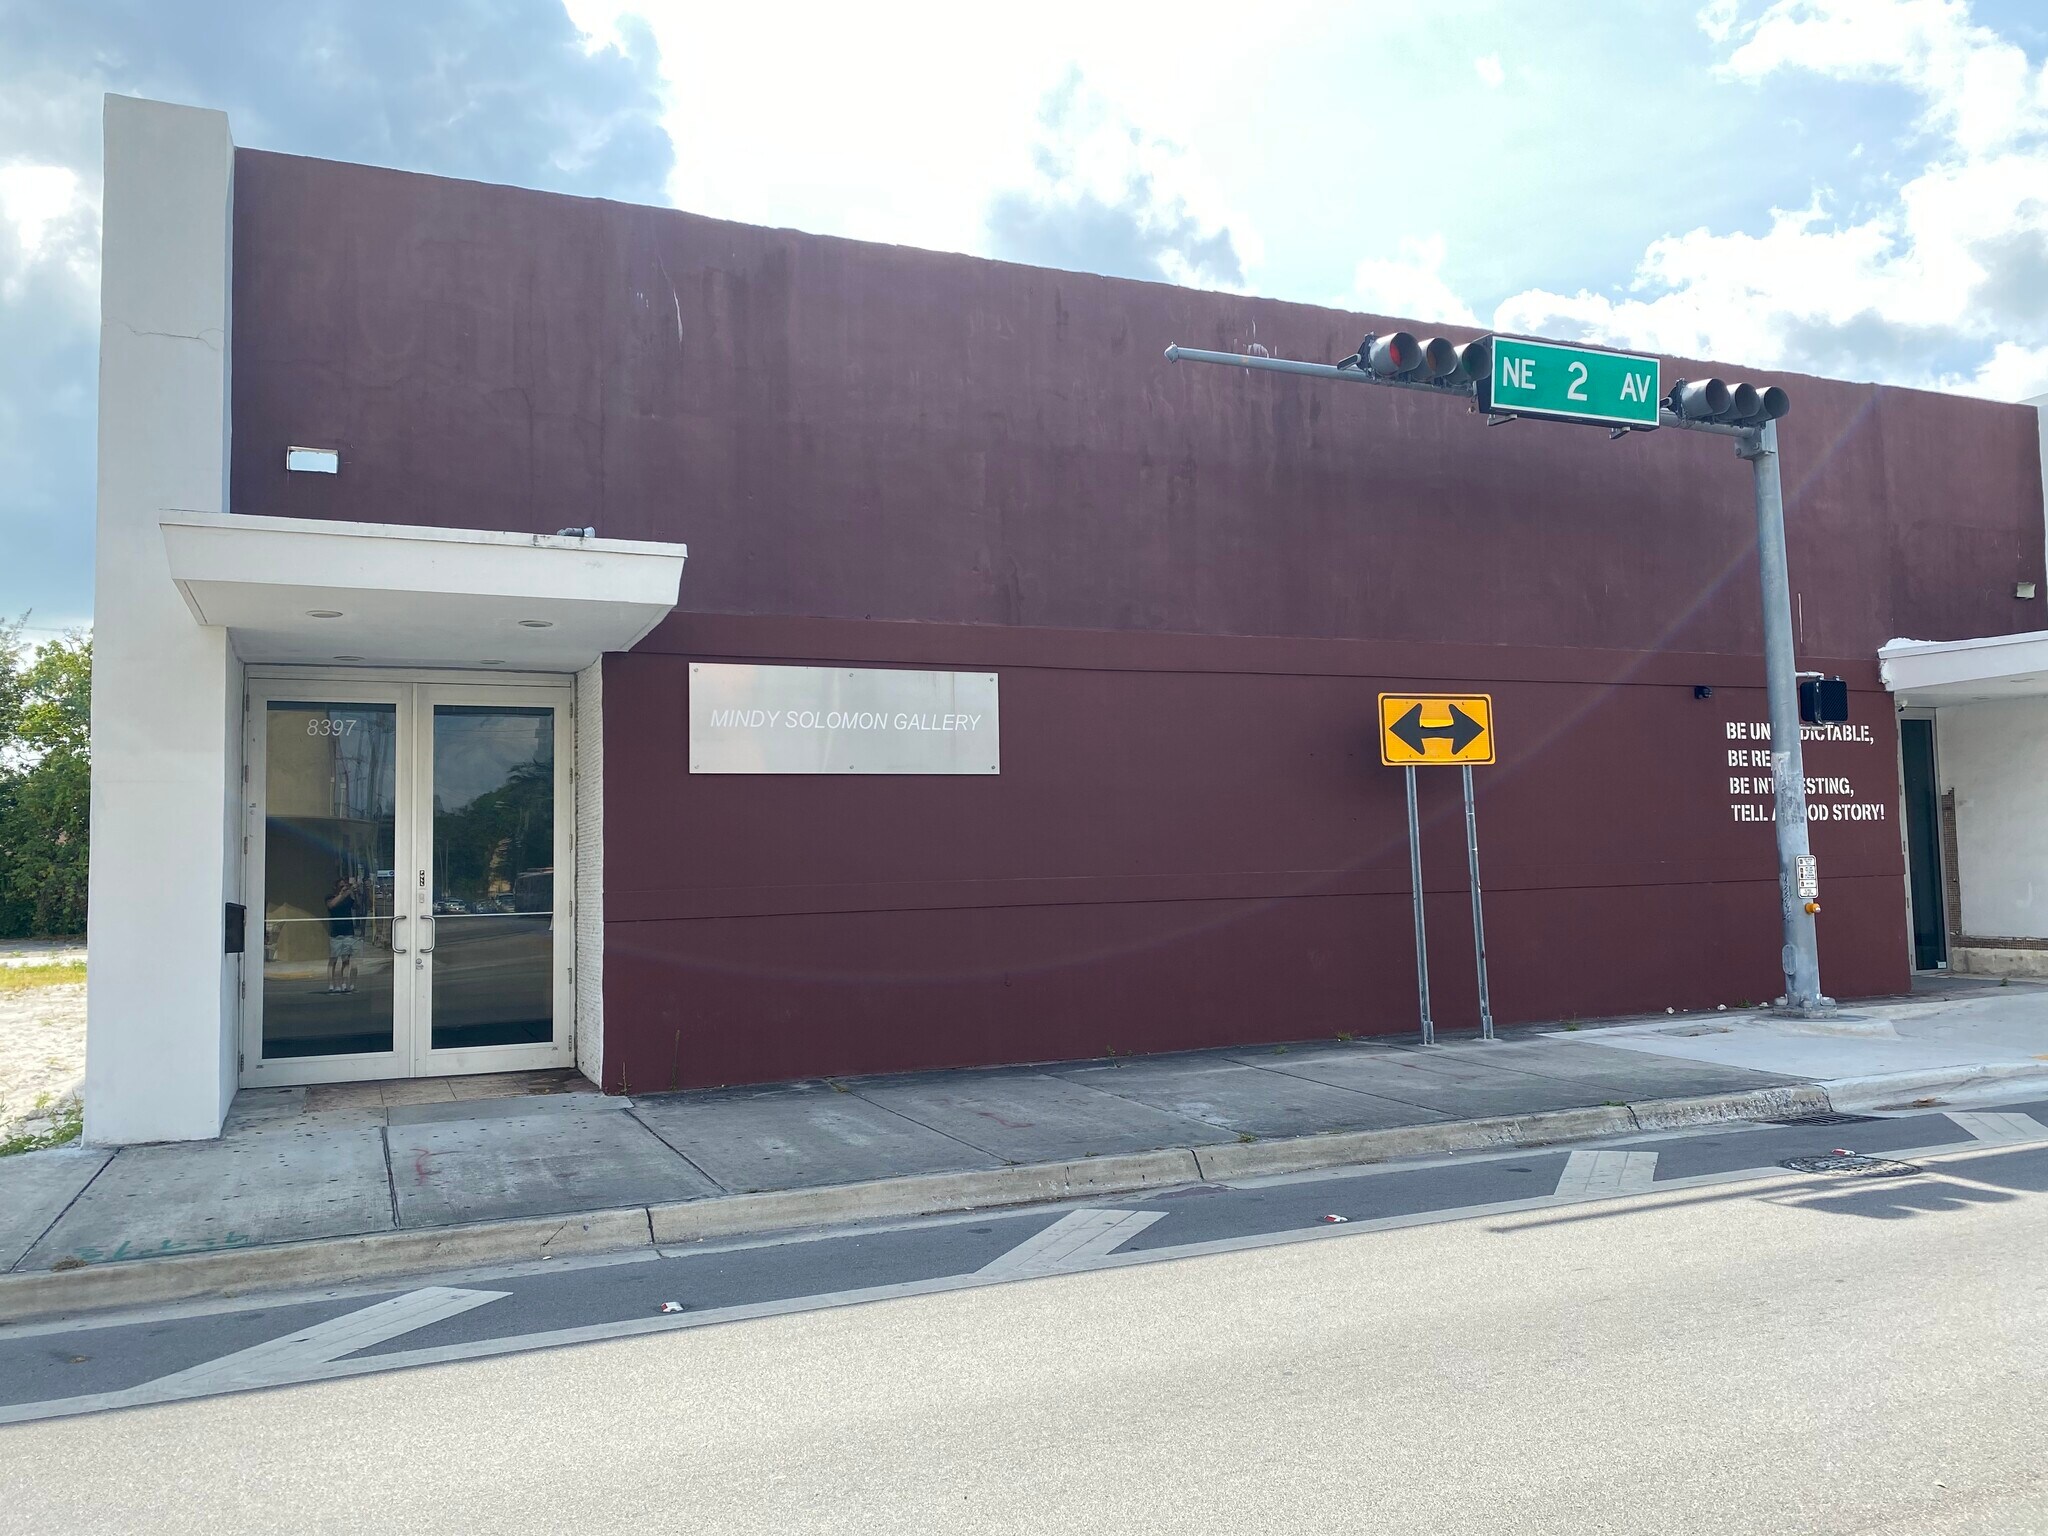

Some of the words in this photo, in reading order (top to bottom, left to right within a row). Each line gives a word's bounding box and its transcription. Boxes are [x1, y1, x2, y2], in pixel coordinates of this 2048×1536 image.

[1502, 356, 1536, 390] NE
[1567, 361, 1588, 402] 2
[1619, 372, 1651, 403] AV
[306, 718, 358, 737] 8397
[710, 709, 781, 728] MINDY
[785, 710, 888, 730] SOLOMON
[894, 712, 982, 731] GALLERY
[1726, 722, 1747, 740] BE
[1750, 722, 1874, 745] UNDICTABLE,
[1727, 750, 1749, 767] BE
[1729, 777, 1750, 795] BE
[1731, 804, 1769, 822] TELL
[1832, 803, 1885, 821] STORY!
